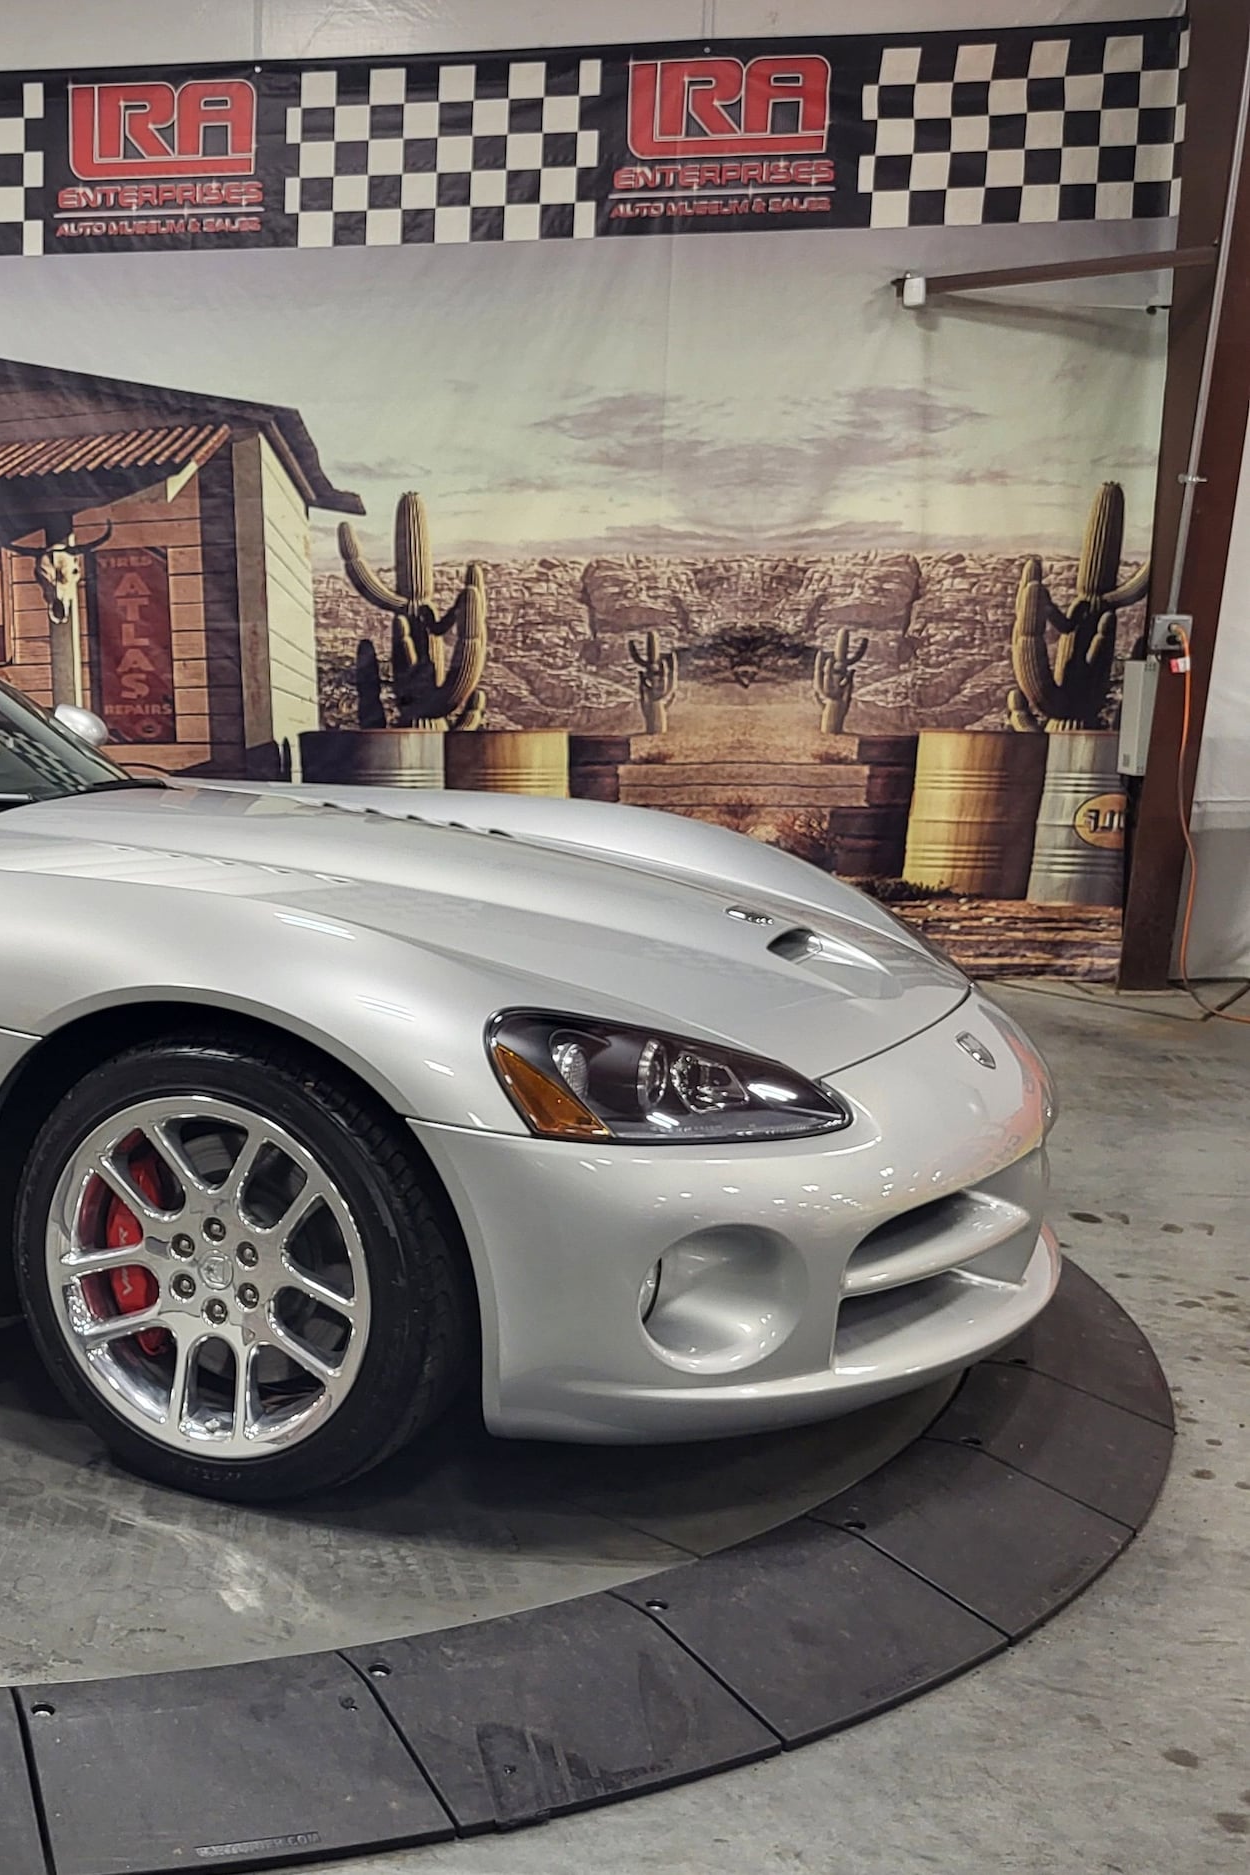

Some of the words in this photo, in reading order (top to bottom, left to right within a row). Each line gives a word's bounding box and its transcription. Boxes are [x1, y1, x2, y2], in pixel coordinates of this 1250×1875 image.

[627, 54, 832, 160] LRA
[68, 78, 257, 181] LRA
[613, 160, 836, 190] ENTERPRISES
[58, 181, 263, 209] ENTERPRISES
[610, 202, 664, 219] AUTO
[666, 199, 749, 217] MUSEUM
[751, 198, 766, 214] &
[768, 196, 831, 213] SALES
[56, 221, 106, 237] AUTO
[107, 219, 185, 236] MUSEUM
[187, 218, 201, 234] &
[202, 217, 262, 233] SALES
[113, 571, 156, 700] ATLAS
[104, 702, 173, 717] REPAIRS
